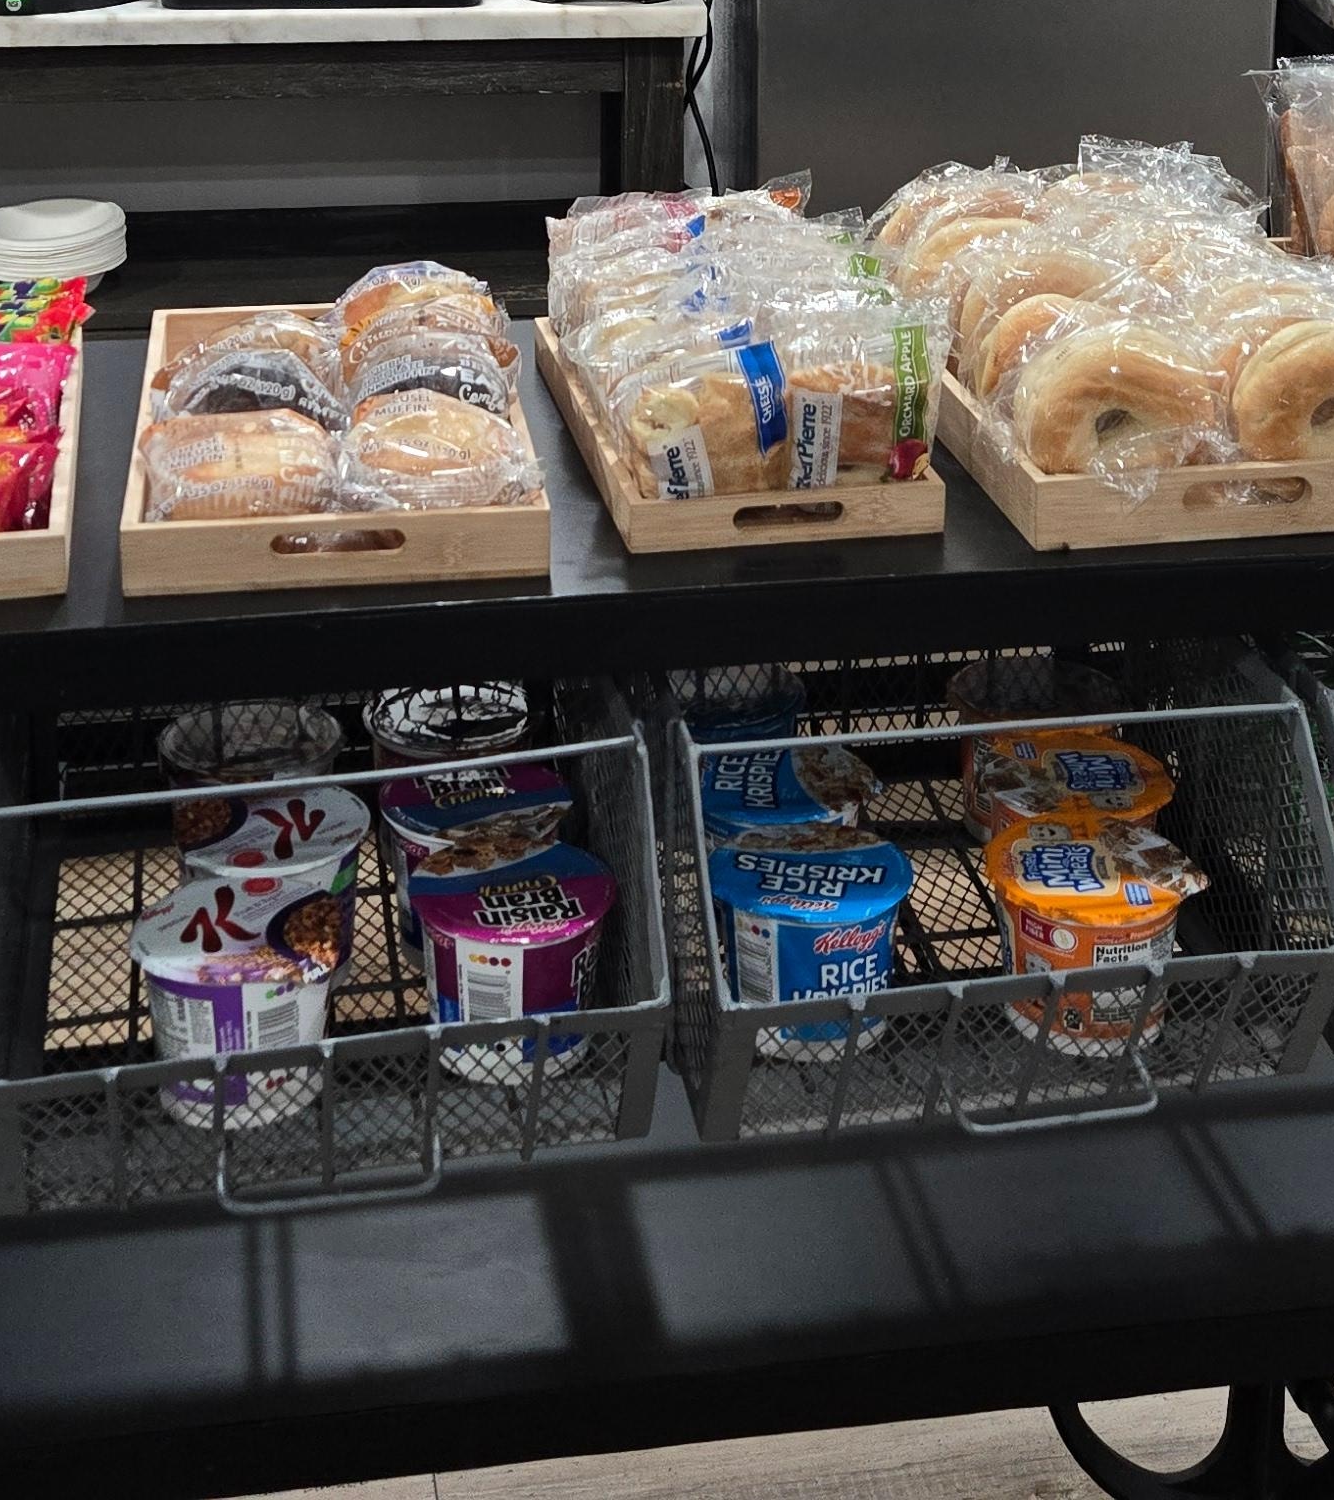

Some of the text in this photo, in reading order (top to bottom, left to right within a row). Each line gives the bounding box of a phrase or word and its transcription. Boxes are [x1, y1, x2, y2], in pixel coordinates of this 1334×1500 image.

[754, 376, 772, 424] CHEESE
[899, 330, 917, 437] ORCHARD APPLE
[821, 403, 833, 425] 1922
[714, 755, 749, 792] RICE
[744, 748, 784, 809] KRISPIE
[736, 854, 885, 885] KRISPIES
[760, 873, 845, 898] RICE
[1038, 847, 1075, 888] Mini
[1069, 845, 1103, 893] Wheats
[473, 897, 586, 928] Raisin
[478, 884, 568, 911] Bran
[812, 918, 889, 955] Kellogg's
[1095, 942, 1148, 956] Nutrition
[820, 952, 879, 989] RICE
[1095, 954, 1129, 963] Facts
